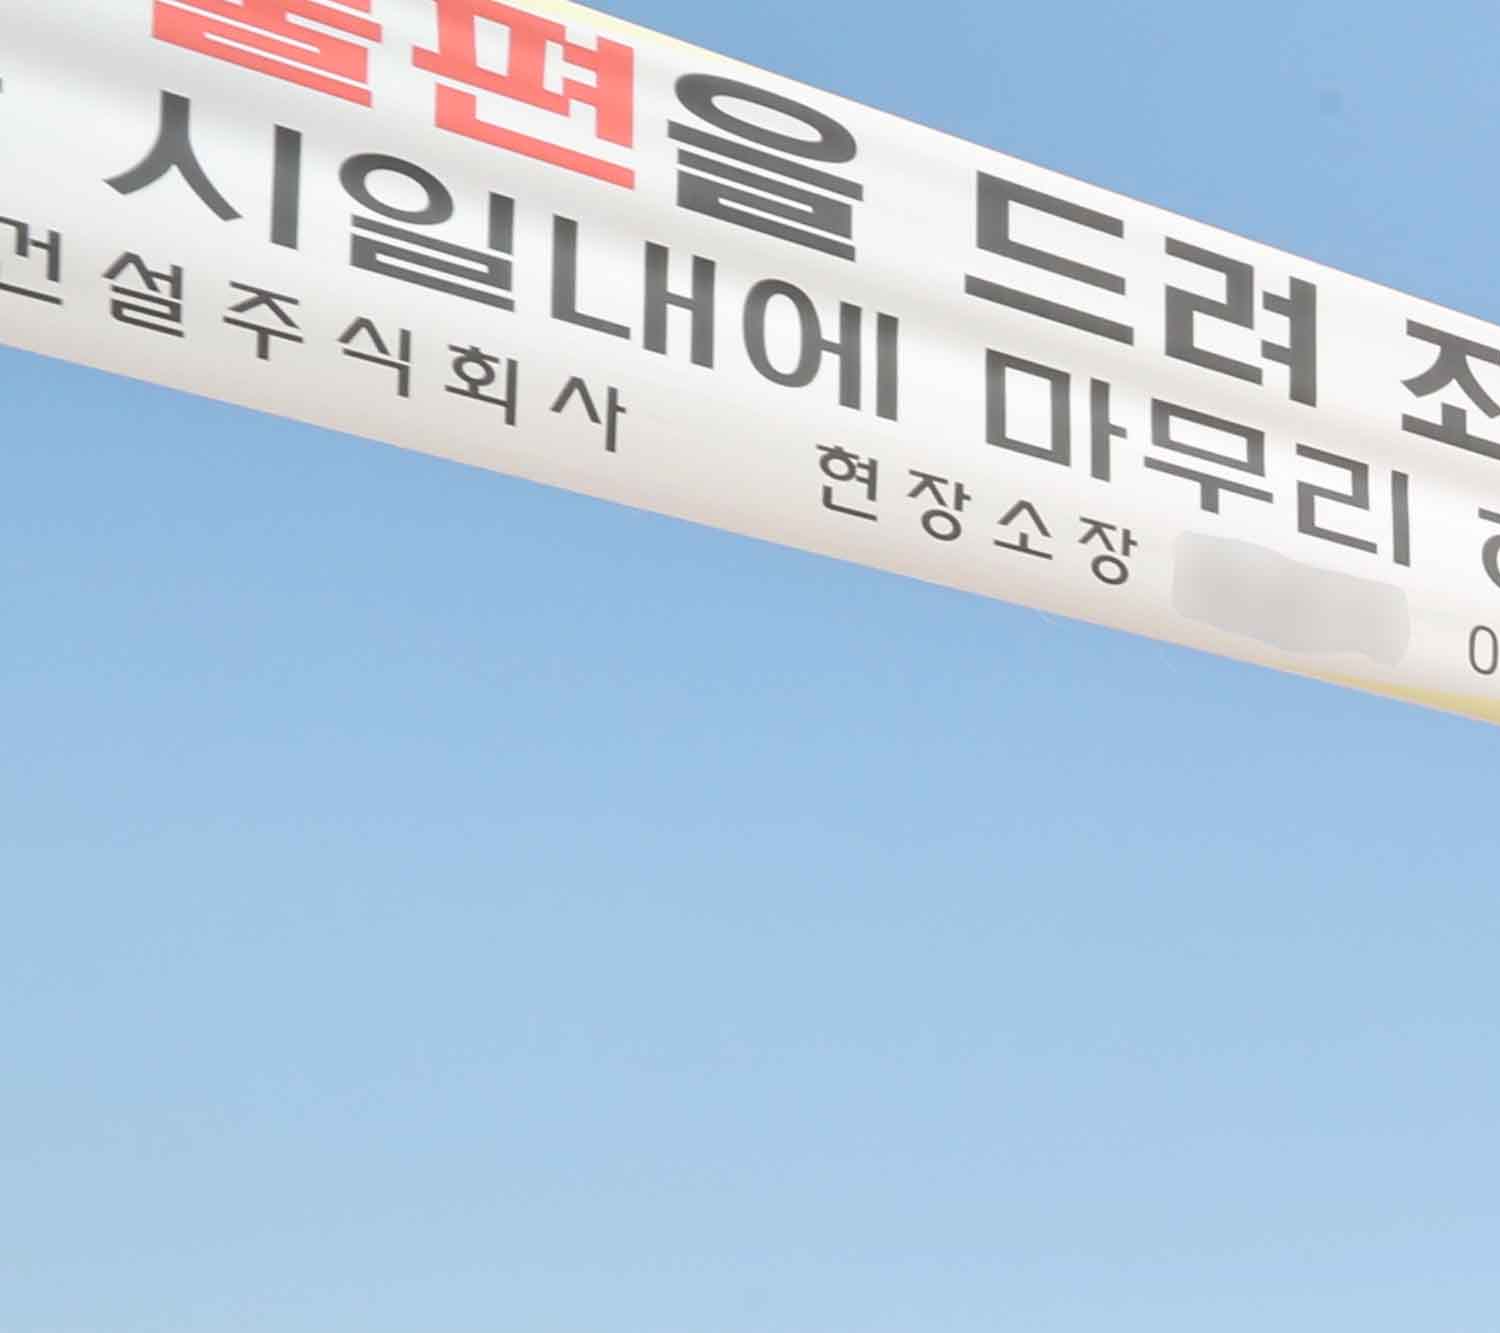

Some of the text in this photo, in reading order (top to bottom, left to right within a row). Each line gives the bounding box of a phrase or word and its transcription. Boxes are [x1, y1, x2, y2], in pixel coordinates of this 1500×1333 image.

[102, 89, 899, 420] 시일내에
[985, 347, 1408, 568] 마무리
[965, 171, 1318, 409] 드려
[816, 442, 1139, 587] 현장소장
